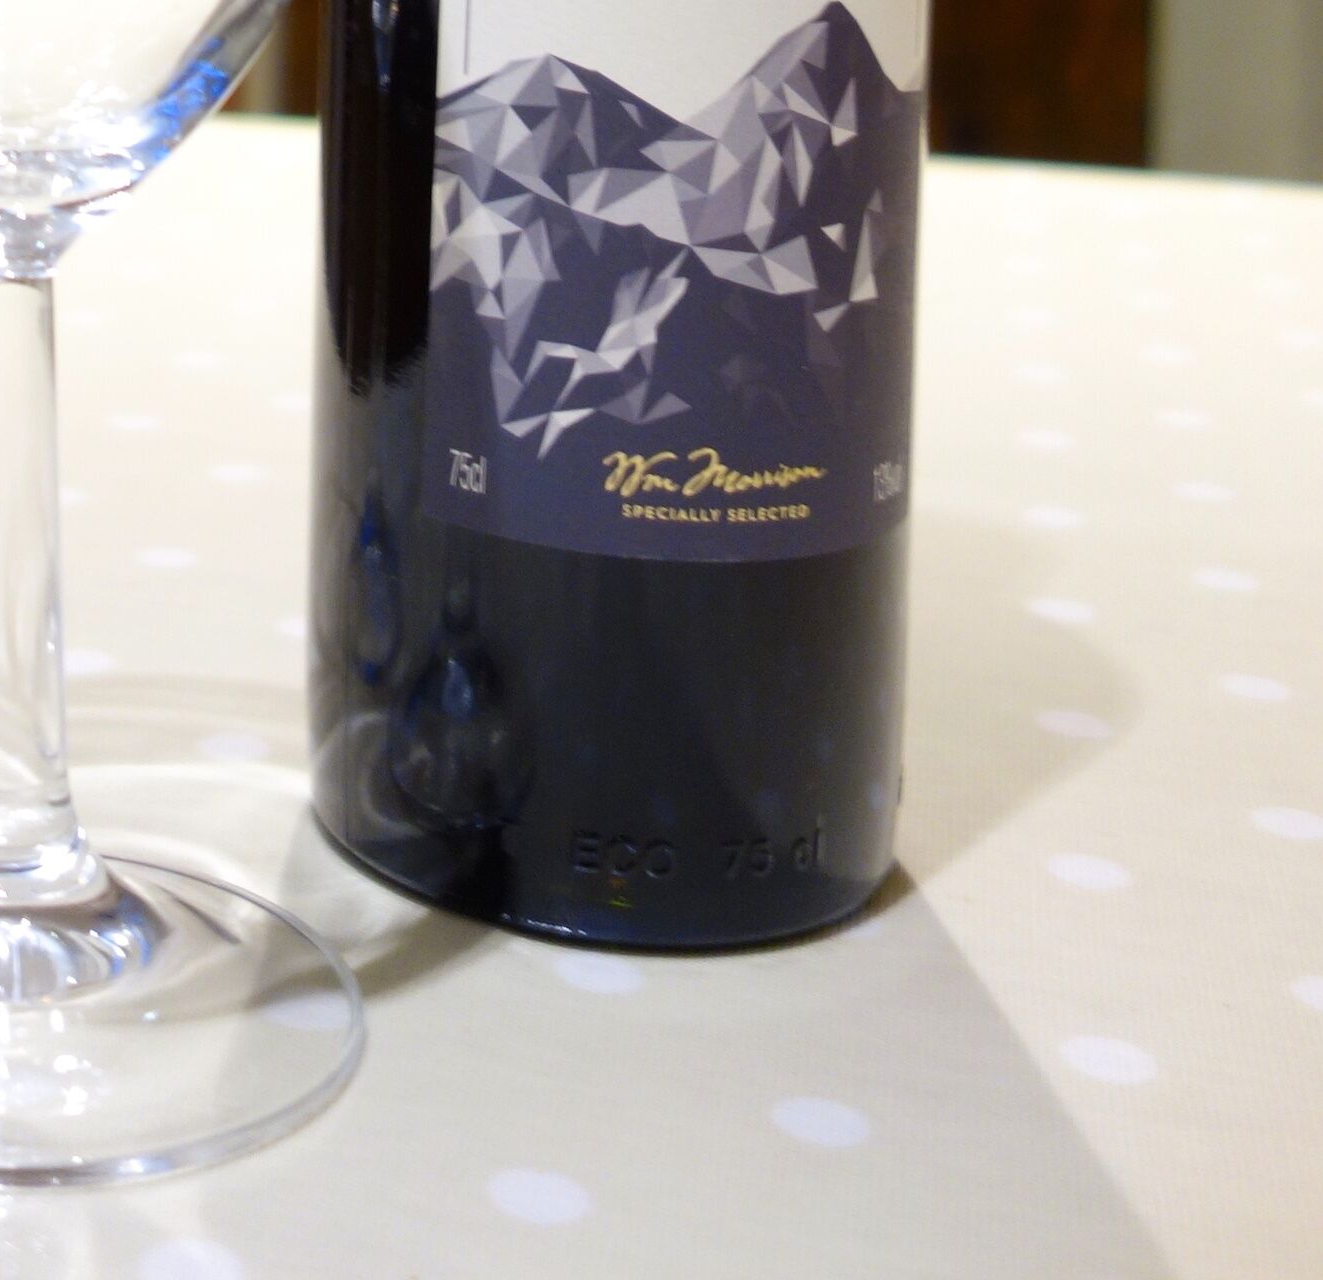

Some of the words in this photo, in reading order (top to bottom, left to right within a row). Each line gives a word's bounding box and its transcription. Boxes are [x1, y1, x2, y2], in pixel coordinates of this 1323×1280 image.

[449, 447, 487, 495] 75cl
[621, 502, 722, 523] SPECIALLY
[726, 503, 811, 523] SELECTED
[722, 837, 774, 879] 75
